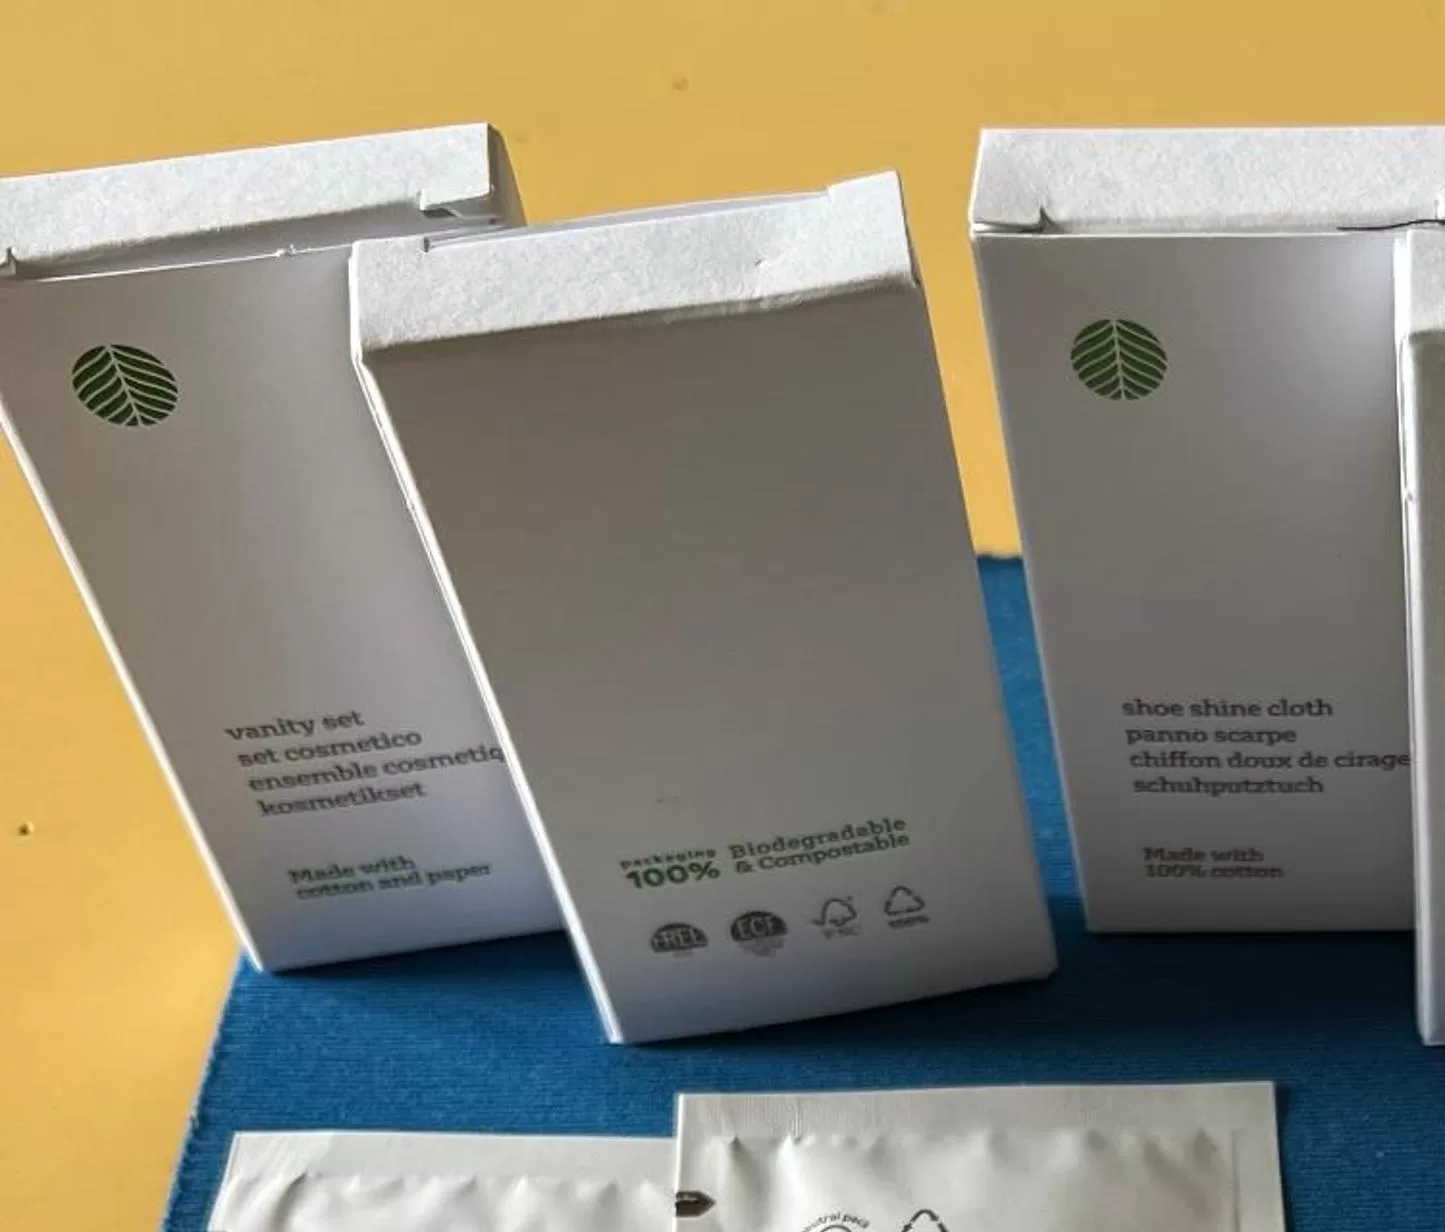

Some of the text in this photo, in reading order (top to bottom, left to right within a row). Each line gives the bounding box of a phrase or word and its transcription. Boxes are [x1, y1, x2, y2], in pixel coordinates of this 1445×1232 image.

[1121, 698, 1333, 717] shoe shine cloth
[225, 711, 365, 741] vanity set
[1125, 728, 1297, 747] panno scarpe
[238, 730, 422, 767] set cosmetico
[1129, 750, 1411, 771] chiffon doux de cirage
[249, 761, 378, 792] ensemble
[1133, 776, 1325, 797] schuhputztuch
[257, 781, 427, 817] kosmetikset
[729, 818, 906, 861] Biodegradable
[736, 833, 910, 874] & Compostable
[1143, 847, 1264, 862] Made with
[288, 855, 415, 884] Made with
[626, 860, 720, 890] 100%
